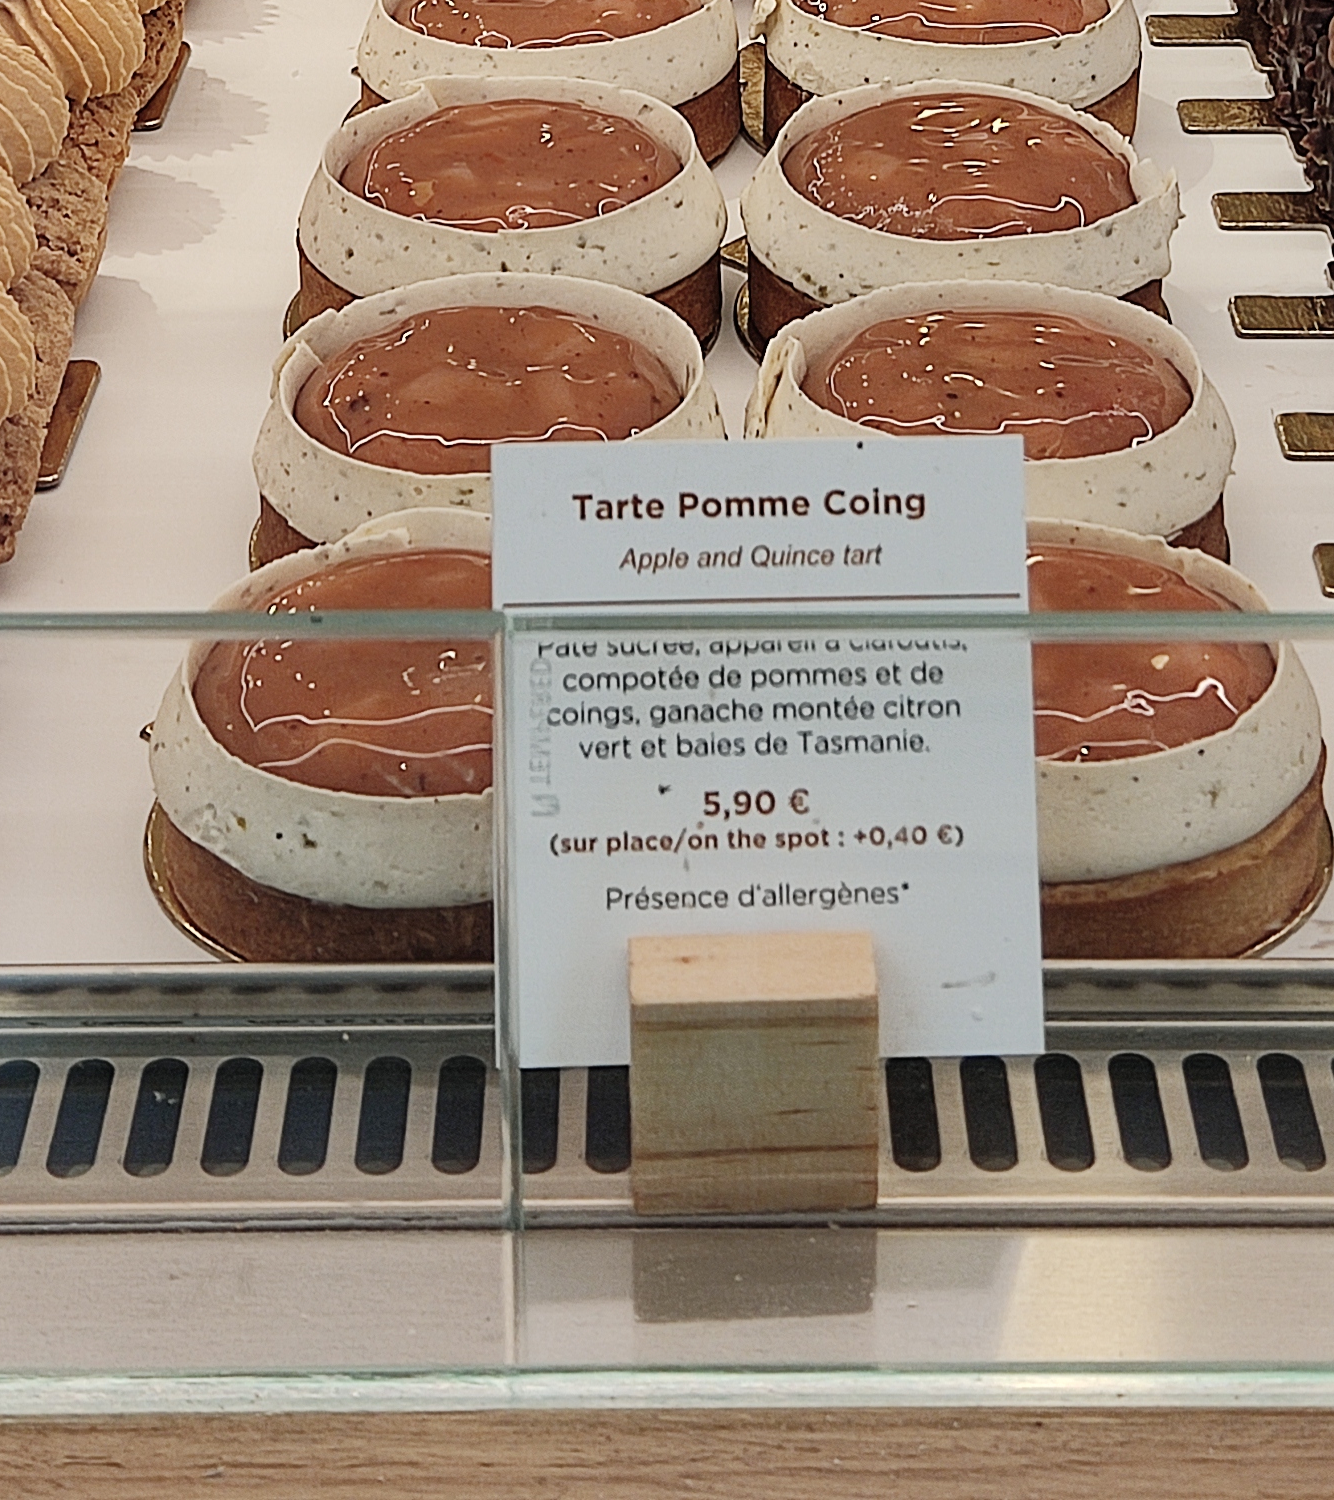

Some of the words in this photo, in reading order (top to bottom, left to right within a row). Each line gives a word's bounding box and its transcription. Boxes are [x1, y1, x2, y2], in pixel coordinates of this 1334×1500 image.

[571, 493, 665, 521] Tarte
[678, 492, 811, 519] Pomme
[823, 487, 926, 520] Coing
[618, 547, 690, 575] Apple
[696, 545, 743, 569] and
[750, 544, 836, 568] Quince
[843, 544, 883, 566] tart
[562, 665, 700, 694] compotée
[708, 664, 742, 689] de
[750, 667, 867, 692] pommes
[875, 663, 902, 686] et
[910, 660, 944, 685] de
[546, 701, 641, 730] coings,
[649, 698, 764, 729] ganache
[772, 695, 875, 721] montée
[883, 696, 961, 720] citron
[578, 736, 632, 760] vert
[640, 736, 667, 759] et
[676, 732, 746, 758] baies
[754, 731, 788, 756] de
[797, 730, 930, 755] Tasmanie.
[703, 790, 776, 821] 5,90
[788, 788, 810, 815] €
[549, 833, 598, 857] (sur
[606, 828, 719, 857] place/on
[727, 828, 767, 850] the
[775, 828, 830, 852] spot
[837, 830, 845, 848] :
[853, 825, 928, 850] +0,40
[936, 824, 964, 848] €)
[606, 886, 729, 911] Présence
